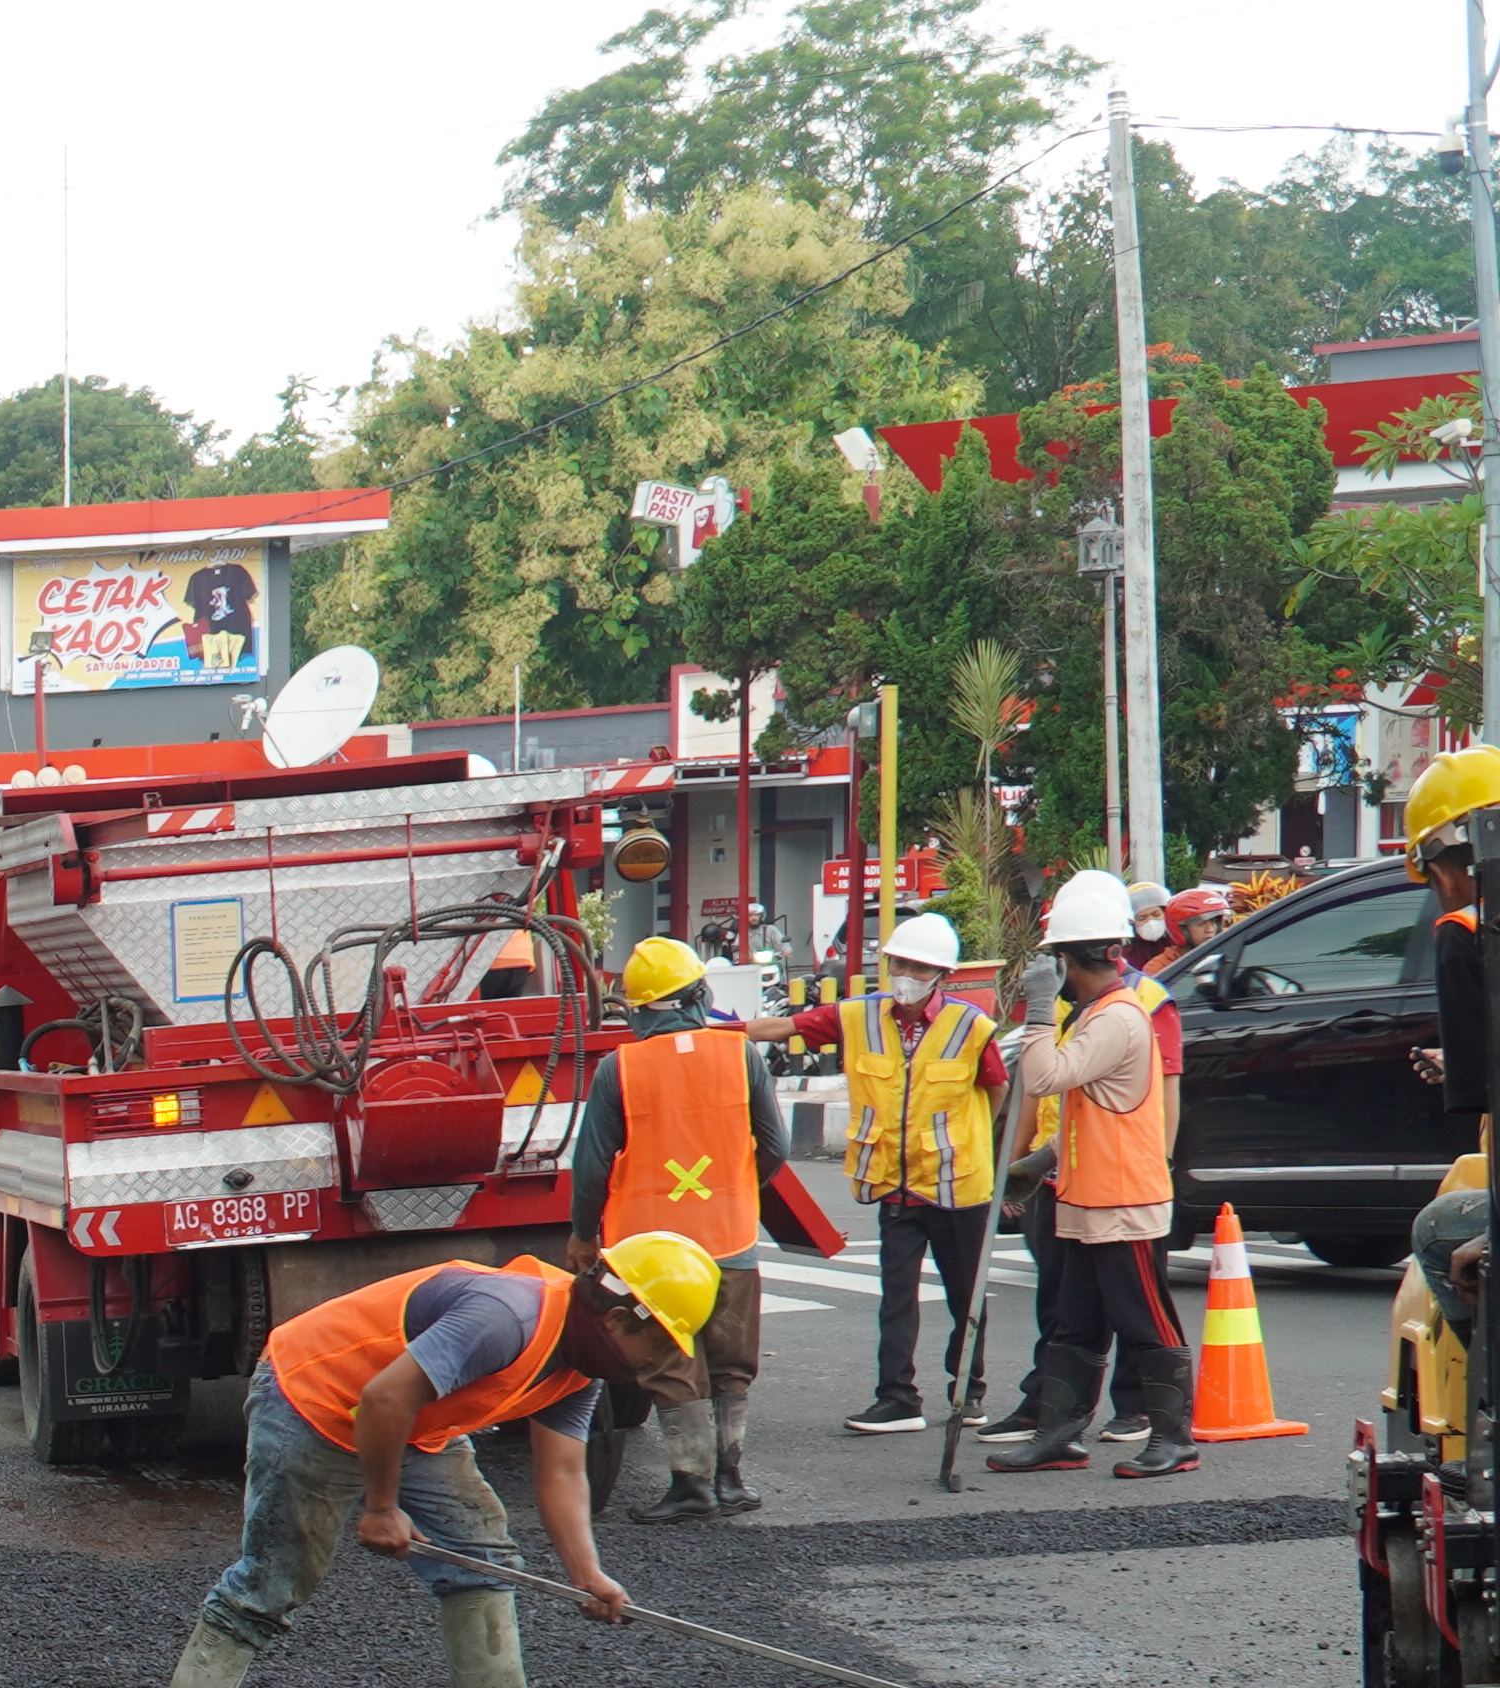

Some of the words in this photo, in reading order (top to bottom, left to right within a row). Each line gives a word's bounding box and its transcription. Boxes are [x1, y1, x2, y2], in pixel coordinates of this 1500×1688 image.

[651, 486, 694, 508] PASTI
[168, 549, 206, 564] HARI
[38, 575, 171, 615] CETAK
[51, 616, 146, 655] KAOS
[173, 1203, 200, 1231] AG
[211, 1196, 267, 1226] 8368
[283, 1192, 311, 1220] PP
